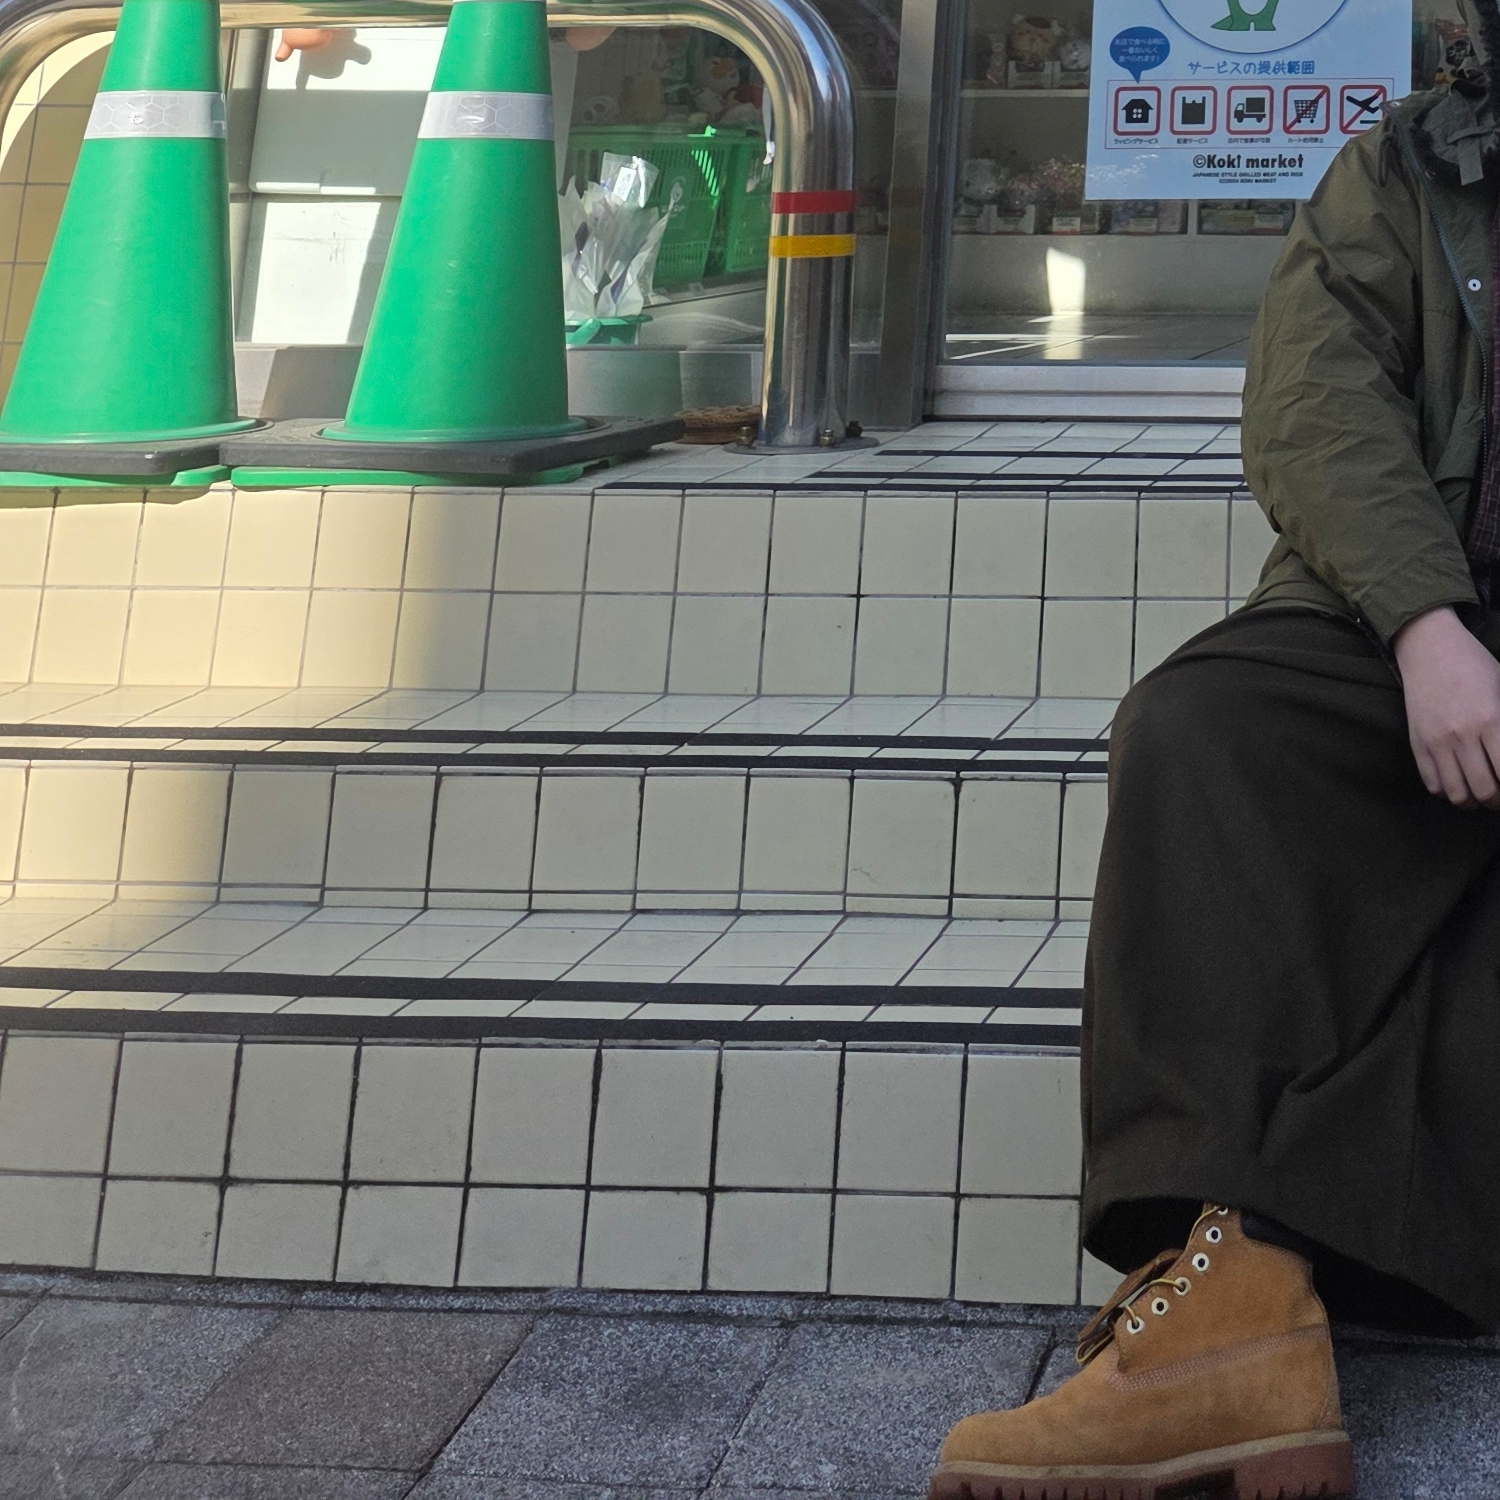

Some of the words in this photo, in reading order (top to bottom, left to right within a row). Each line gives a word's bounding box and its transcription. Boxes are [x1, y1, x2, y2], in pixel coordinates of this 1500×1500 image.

[1187, 59, 1315, 76] サービスの提供範囲
[1245, 153, 1304, 169] market
